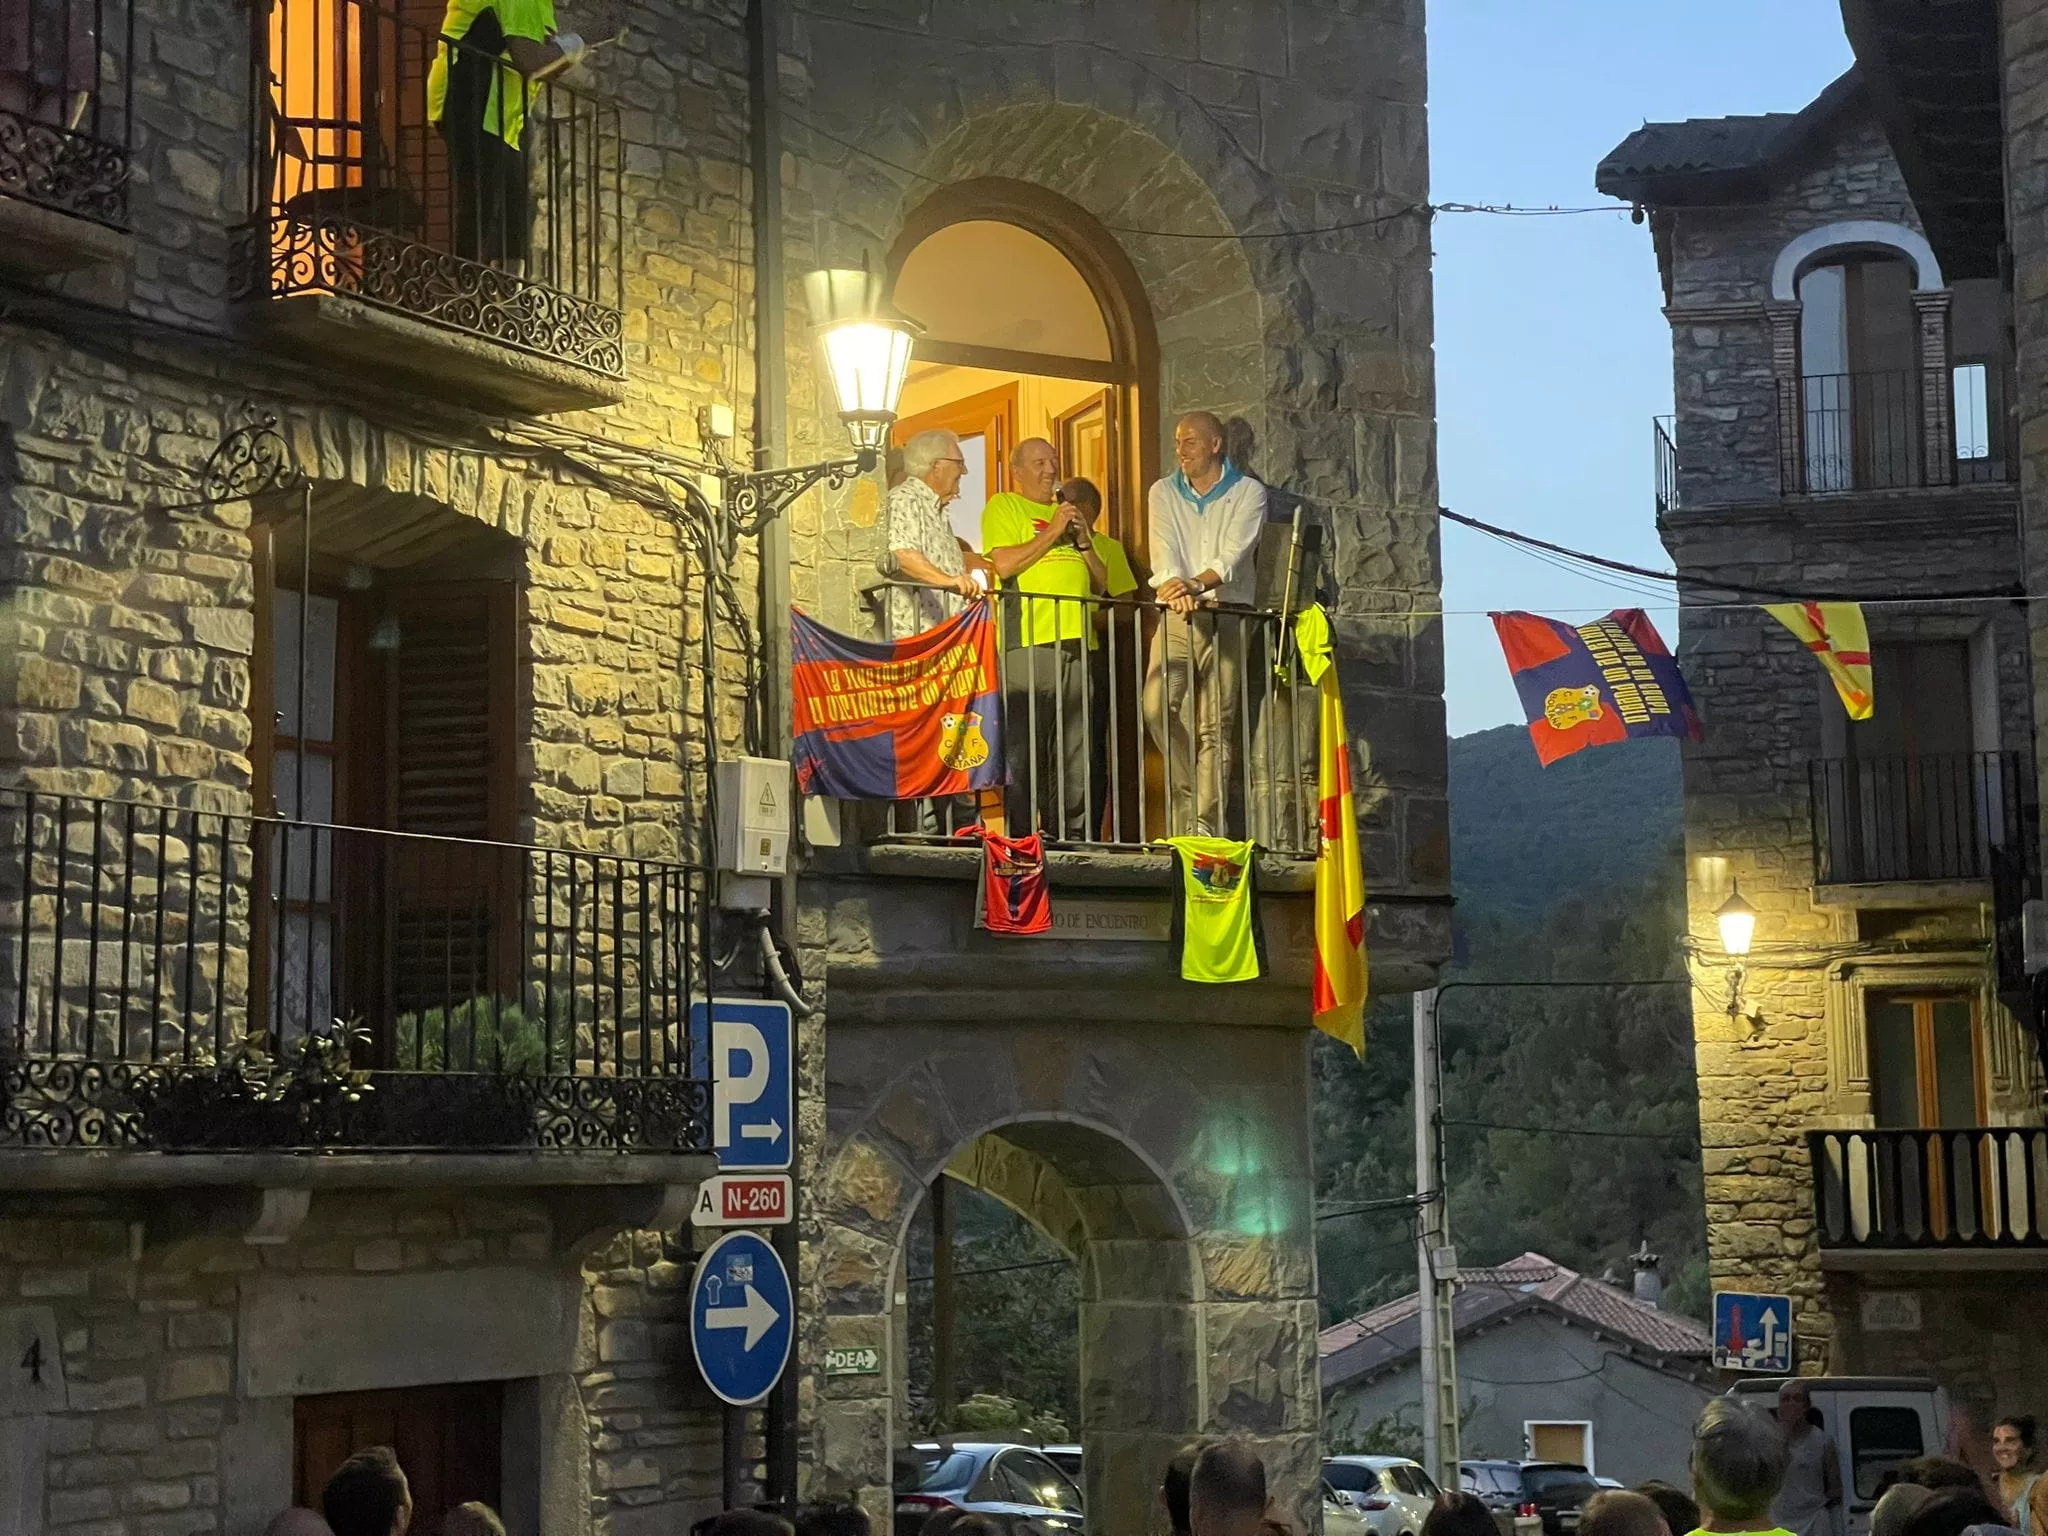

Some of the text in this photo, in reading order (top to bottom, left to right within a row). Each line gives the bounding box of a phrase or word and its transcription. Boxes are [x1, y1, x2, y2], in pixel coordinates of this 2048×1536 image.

[1602, 667, 1631, 683] UN
[1631, 669, 1655, 681] UN
[1610, 683, 1651, 724] PUEBLO
[1085, 914, 1149, 930] ENCUENTRO
[712, 1021, 770, 1148] P
[700, 1187, 780, 1213] A N-260
[20, 1337, 47, 1384] 4
[835, 1351, 866, 1368] DEA
